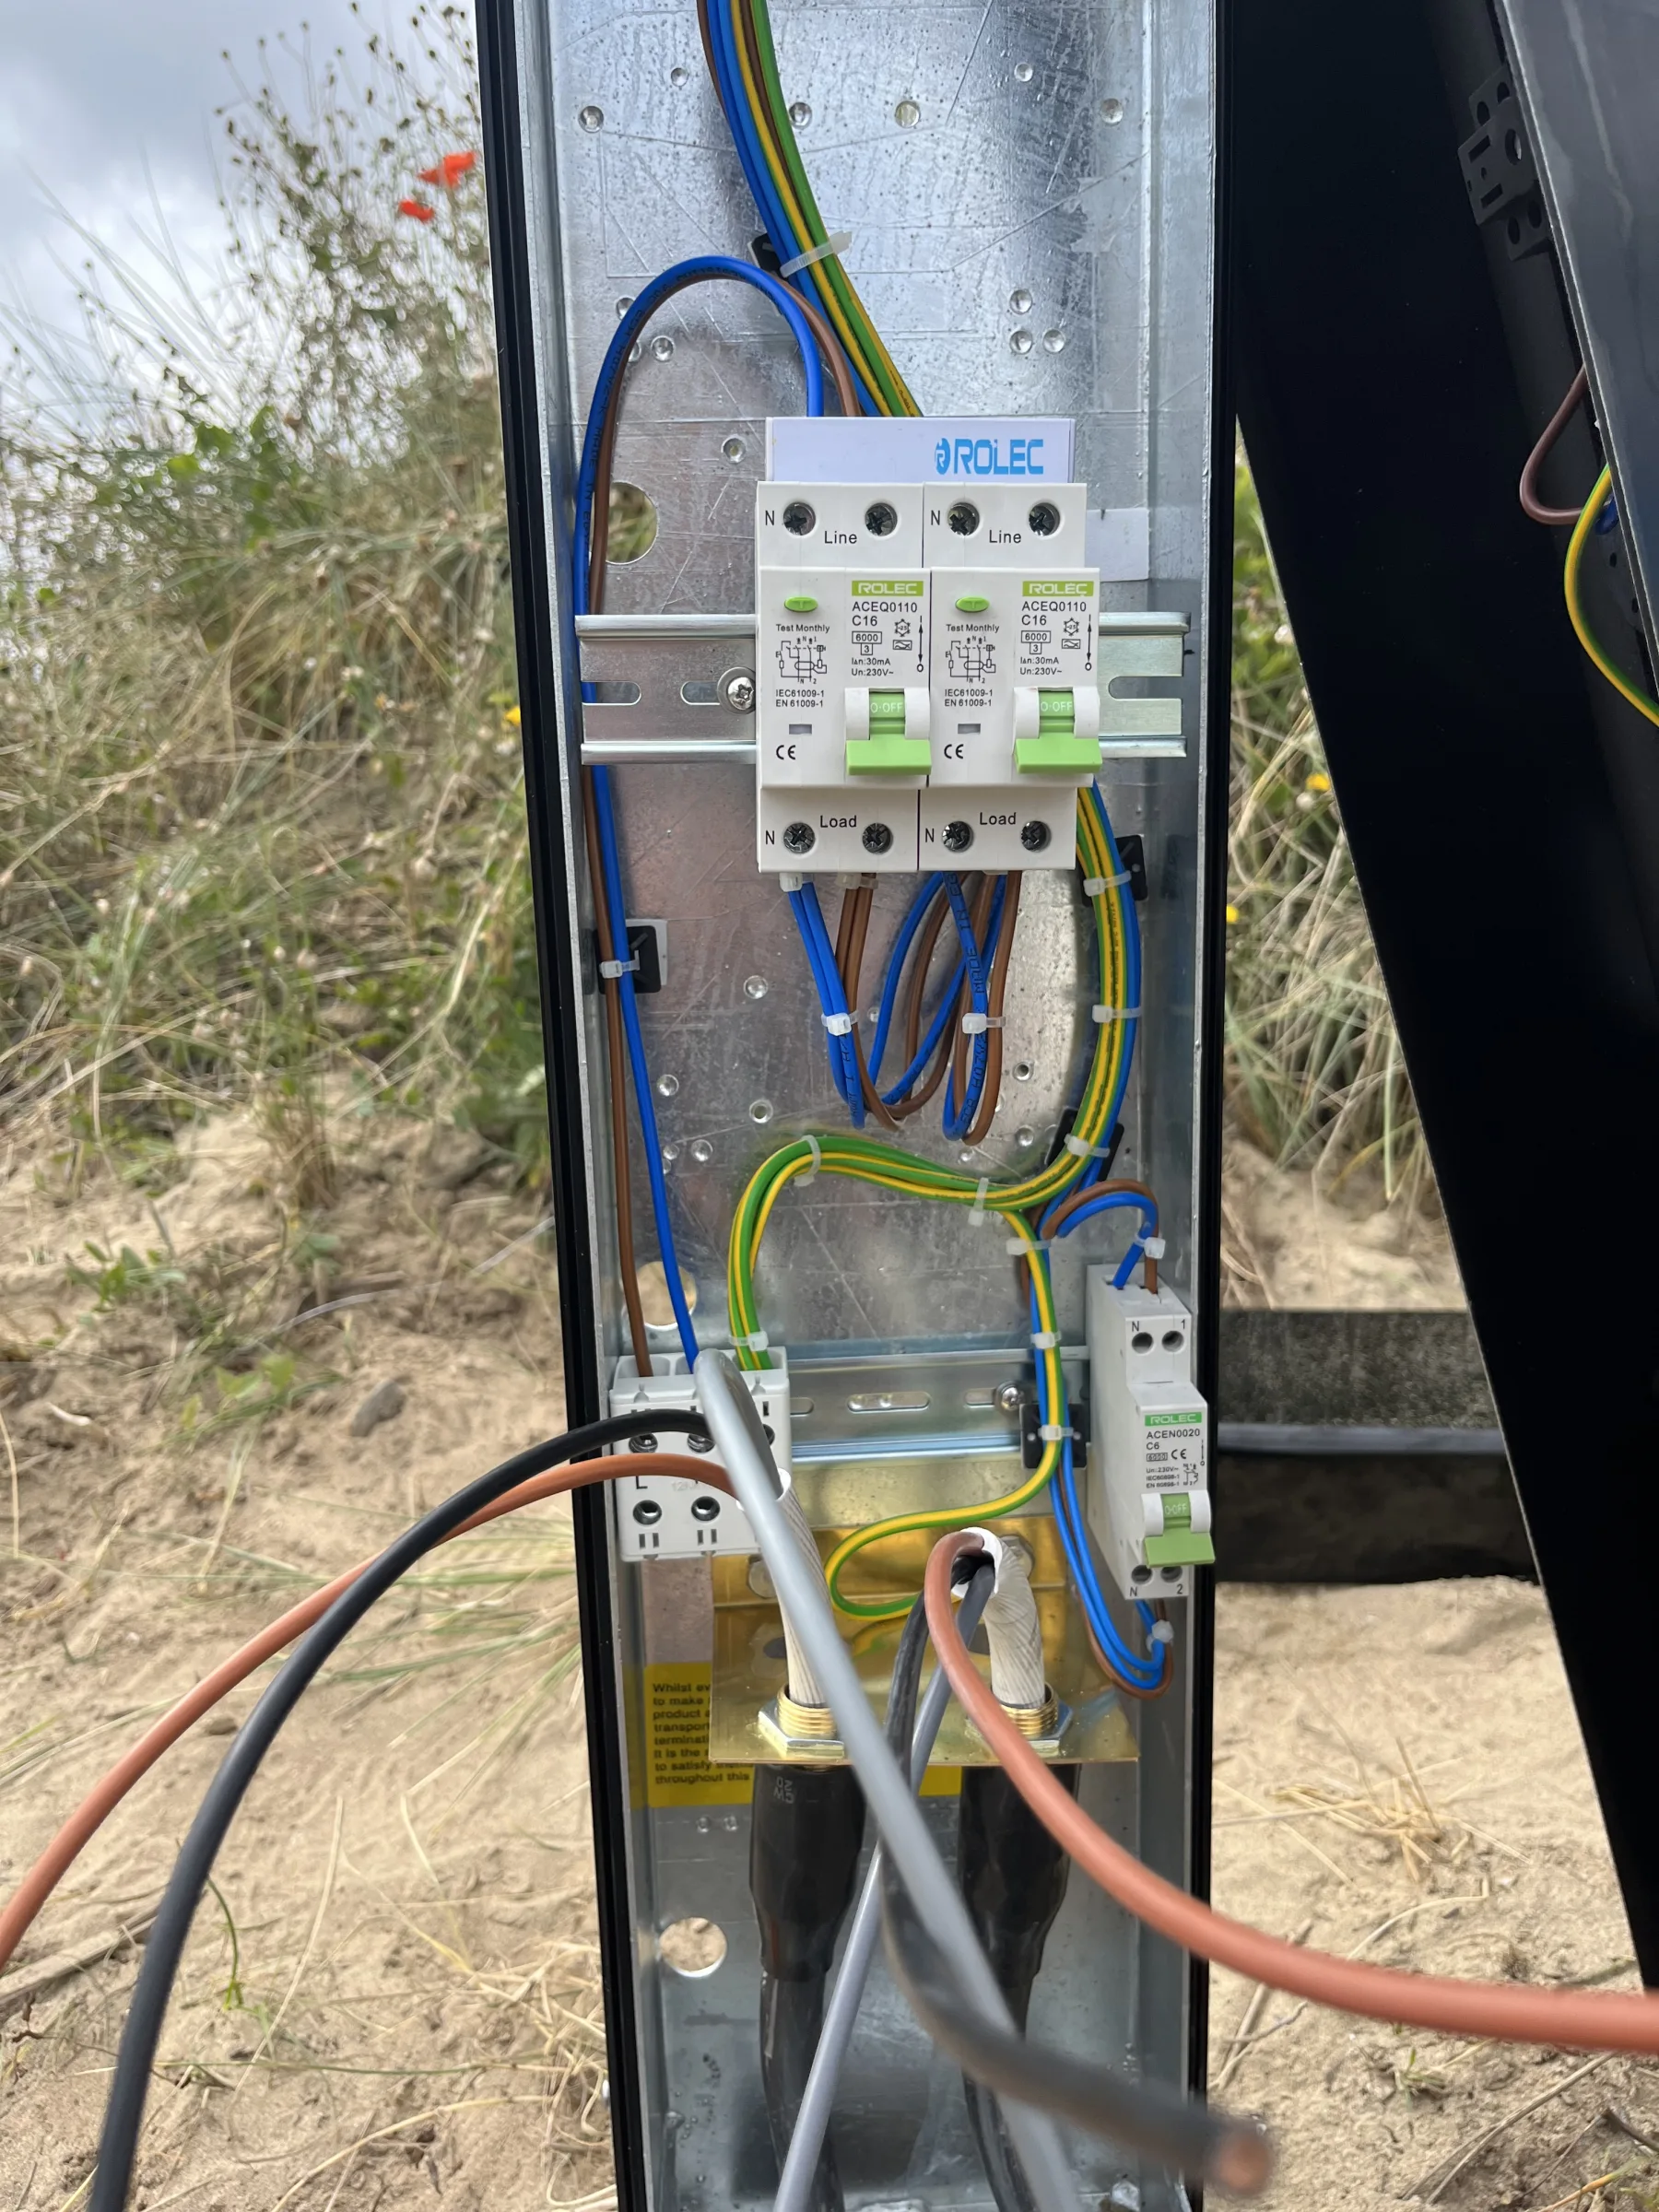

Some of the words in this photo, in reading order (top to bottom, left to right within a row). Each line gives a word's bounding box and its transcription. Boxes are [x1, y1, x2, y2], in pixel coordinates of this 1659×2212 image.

[954, 439, 1044, 475] ROLEC
[765, 511, 775, 525] N
[930, 511, 940, 525] N
[824, 530, 858, 545] Line
[989, 529, 1022, 544] Line
[858, 582, 917, 594] ROLEC
[1029, 582, 1088, 594] ROLEC
[852, 601, 918, 613] ACEQ0110
[1021, 601, 1087, 612] ACEQ0110
[852, 615, 877, 627] C16
[1021, 614, 1047, 626] C16
[776, 624, 794, 632] Test
[796, 624, 830, 634] Monthly
[946, 624, 964, 632] Test
[966, 624, 1000, 633] Monthly
[855, 633, 878, 642] 6000
[1025, 632, 1048, 641] 6000
[864, 645, 870, 654] 3
[1033, 644, 1039, 653] 3
[776, 689, 825, 698] IEC61009-1
[945, 688, 993, 697] IEC61009-1
[776, 700, 788, 708] EN
[945, 699, 957, 707] EN
[959, 699, 992, 707] 61009-1
[776, 745, 796, 760] CE
[944, 744, 964, 759] CE
[819, 814, 858, 829] Load
[980, 812, 1017, 826] Load
[765, 830, 775, 845] N
[924, 828, 935, 843] N
[1131, 1320, 1140, 1332] N
[1181, 1319, 1186, 1330] 1
[1150, 1413, 1196, 1424] ROLEC
[1147, 1428, 1201, 1440] ACEN0020
[1147, 1441, 1160, 1451] C6
[1171, 1449, 1187, 1460] CE
[1130, 1584, 1138, 1597] N
[1177, 1583, 1183, 1595] 2
[653, 1683, 691, 1692] Whilst
[653, 1698, 665, 1706] to
[670, 1696, 704, 1705] make
[653, 1710, 701, 1721] product
[654, 1749, 662, 1758] It
[666, 1748, 677, 1758] is
[680, 1748, 700, 1757] the
[655, 1762, 666, 1771] to
[671, 1760, 712, 1771] satisfy
[655, 1772, 724, 1784] throughout
[727, 1771, 750, 1781] this
